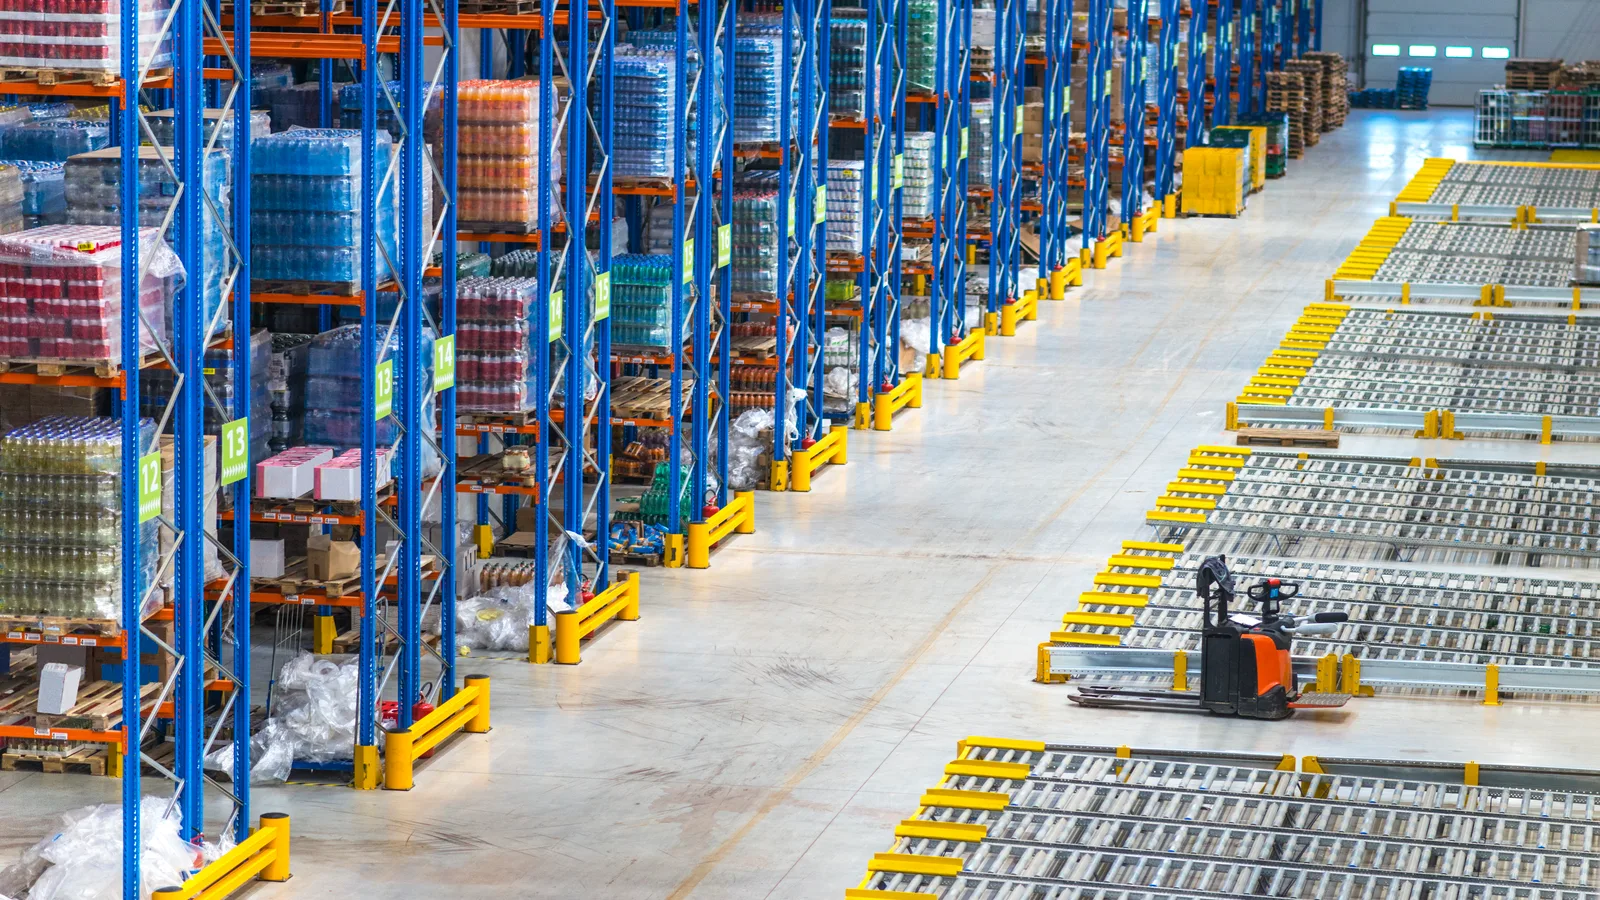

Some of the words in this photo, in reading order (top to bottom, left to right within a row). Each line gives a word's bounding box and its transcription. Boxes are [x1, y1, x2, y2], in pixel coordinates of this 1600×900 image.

[720, 230, 730, 251] 16
[685, 245, 693, 267] 15
[598, 277, 609, 302] 15
[551, 296, 561, 323] 14
[438, 341, 453, 370] 14
[377, 367, 391, 397] 13
[226, 426, 246, 459] 13
[141, 459, 159, 495] 12
